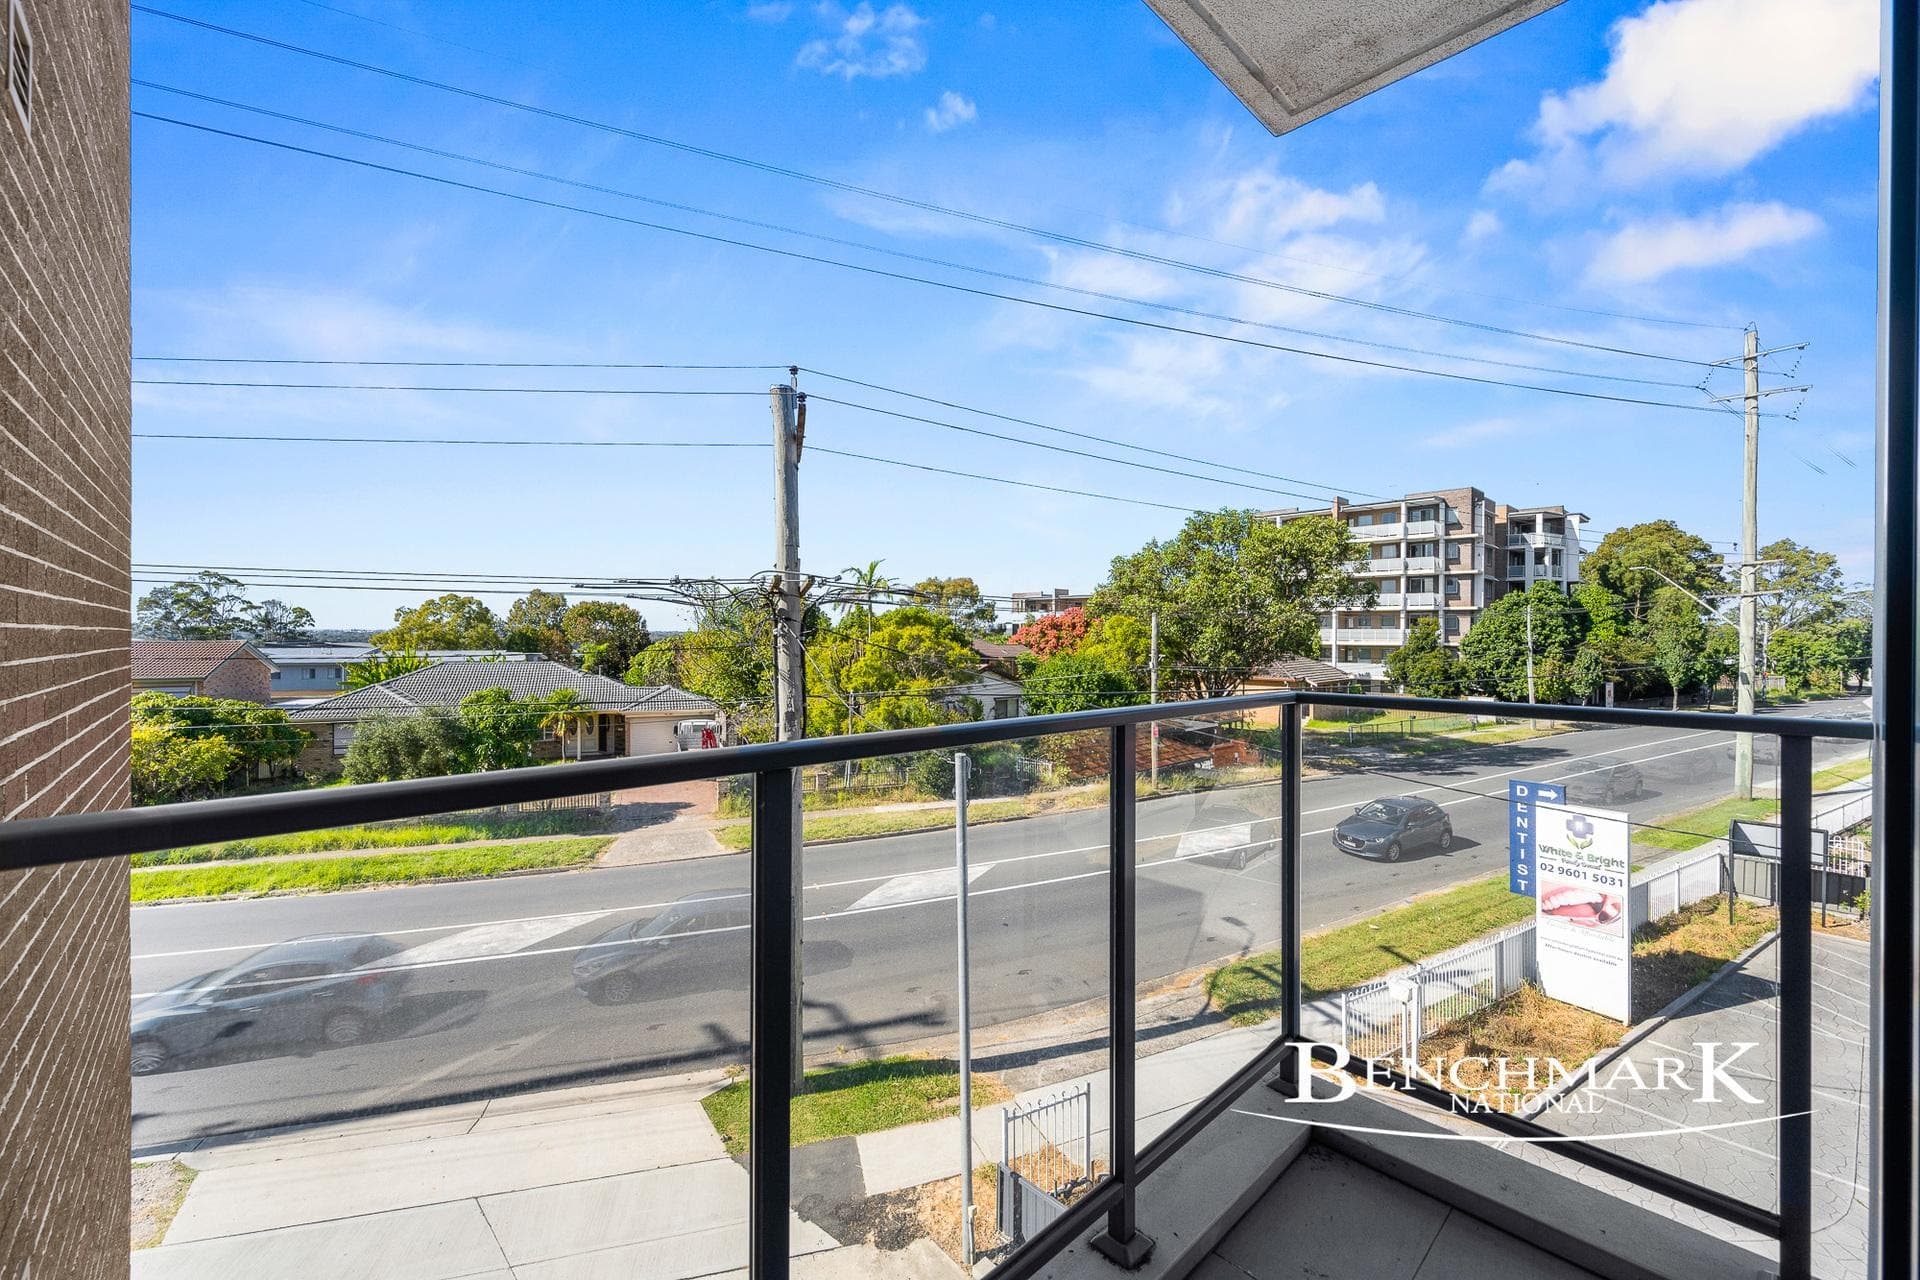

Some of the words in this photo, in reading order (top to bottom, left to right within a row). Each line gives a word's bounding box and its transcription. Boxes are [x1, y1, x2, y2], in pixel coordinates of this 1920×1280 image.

[1516, 785, 1529, 892] DENTIST
[1538, 843, 1573, 859] White
[1575, 851, 1584, 861] &
[1587, 853, 1625, 869] Bright
[1540, 862, 1554, 873] 02
[1557, 866, 1588, 880] 9601
[1592, 873, 1624, 888] 5031
